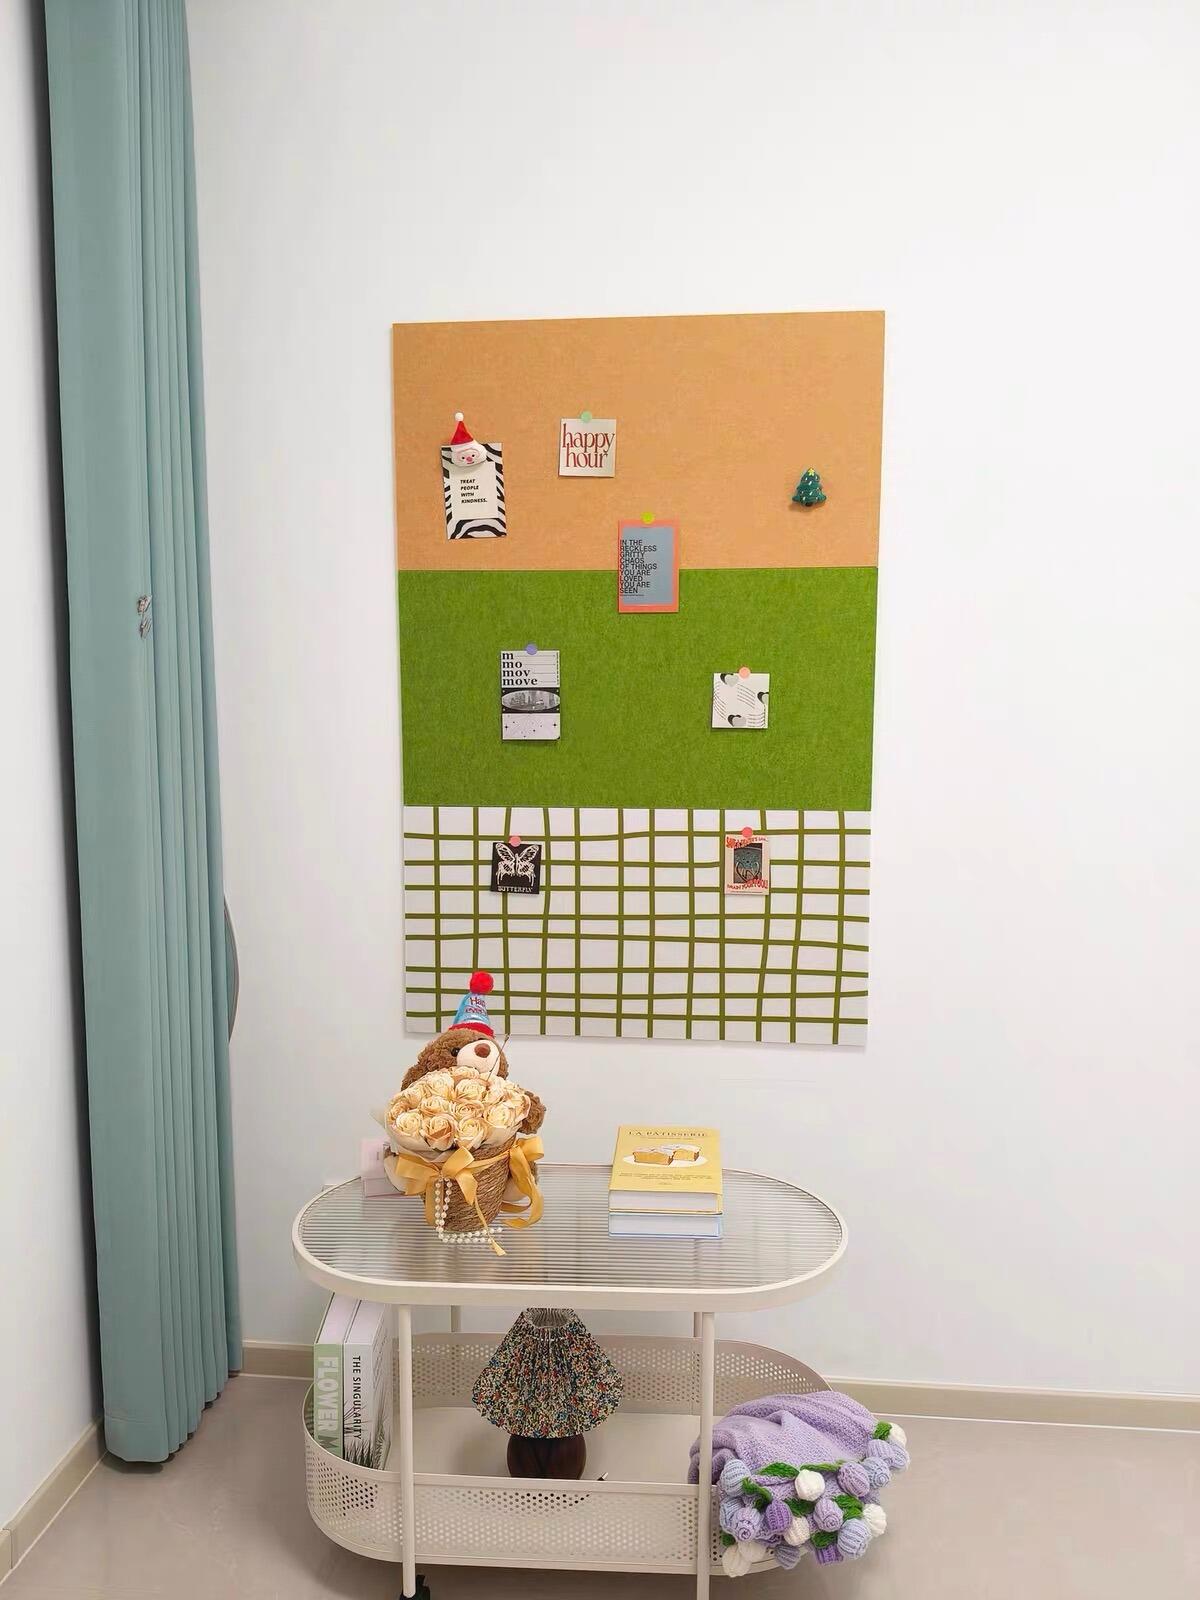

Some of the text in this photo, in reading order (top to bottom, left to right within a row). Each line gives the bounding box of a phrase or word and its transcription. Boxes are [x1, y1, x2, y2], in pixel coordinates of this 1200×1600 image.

[562, 423, 615, 453] happy
[565, 444, 609, 468] hour
[502, 652, 514, 660] m
[502, 660, 522, 668] mo
[502, 669, 531, 677] mov
[502, 678, 538, 686] move
[317, 1357, 339, 1431] FLOWER
[352, 1356, 362, 1439] THE SINGULARITY
